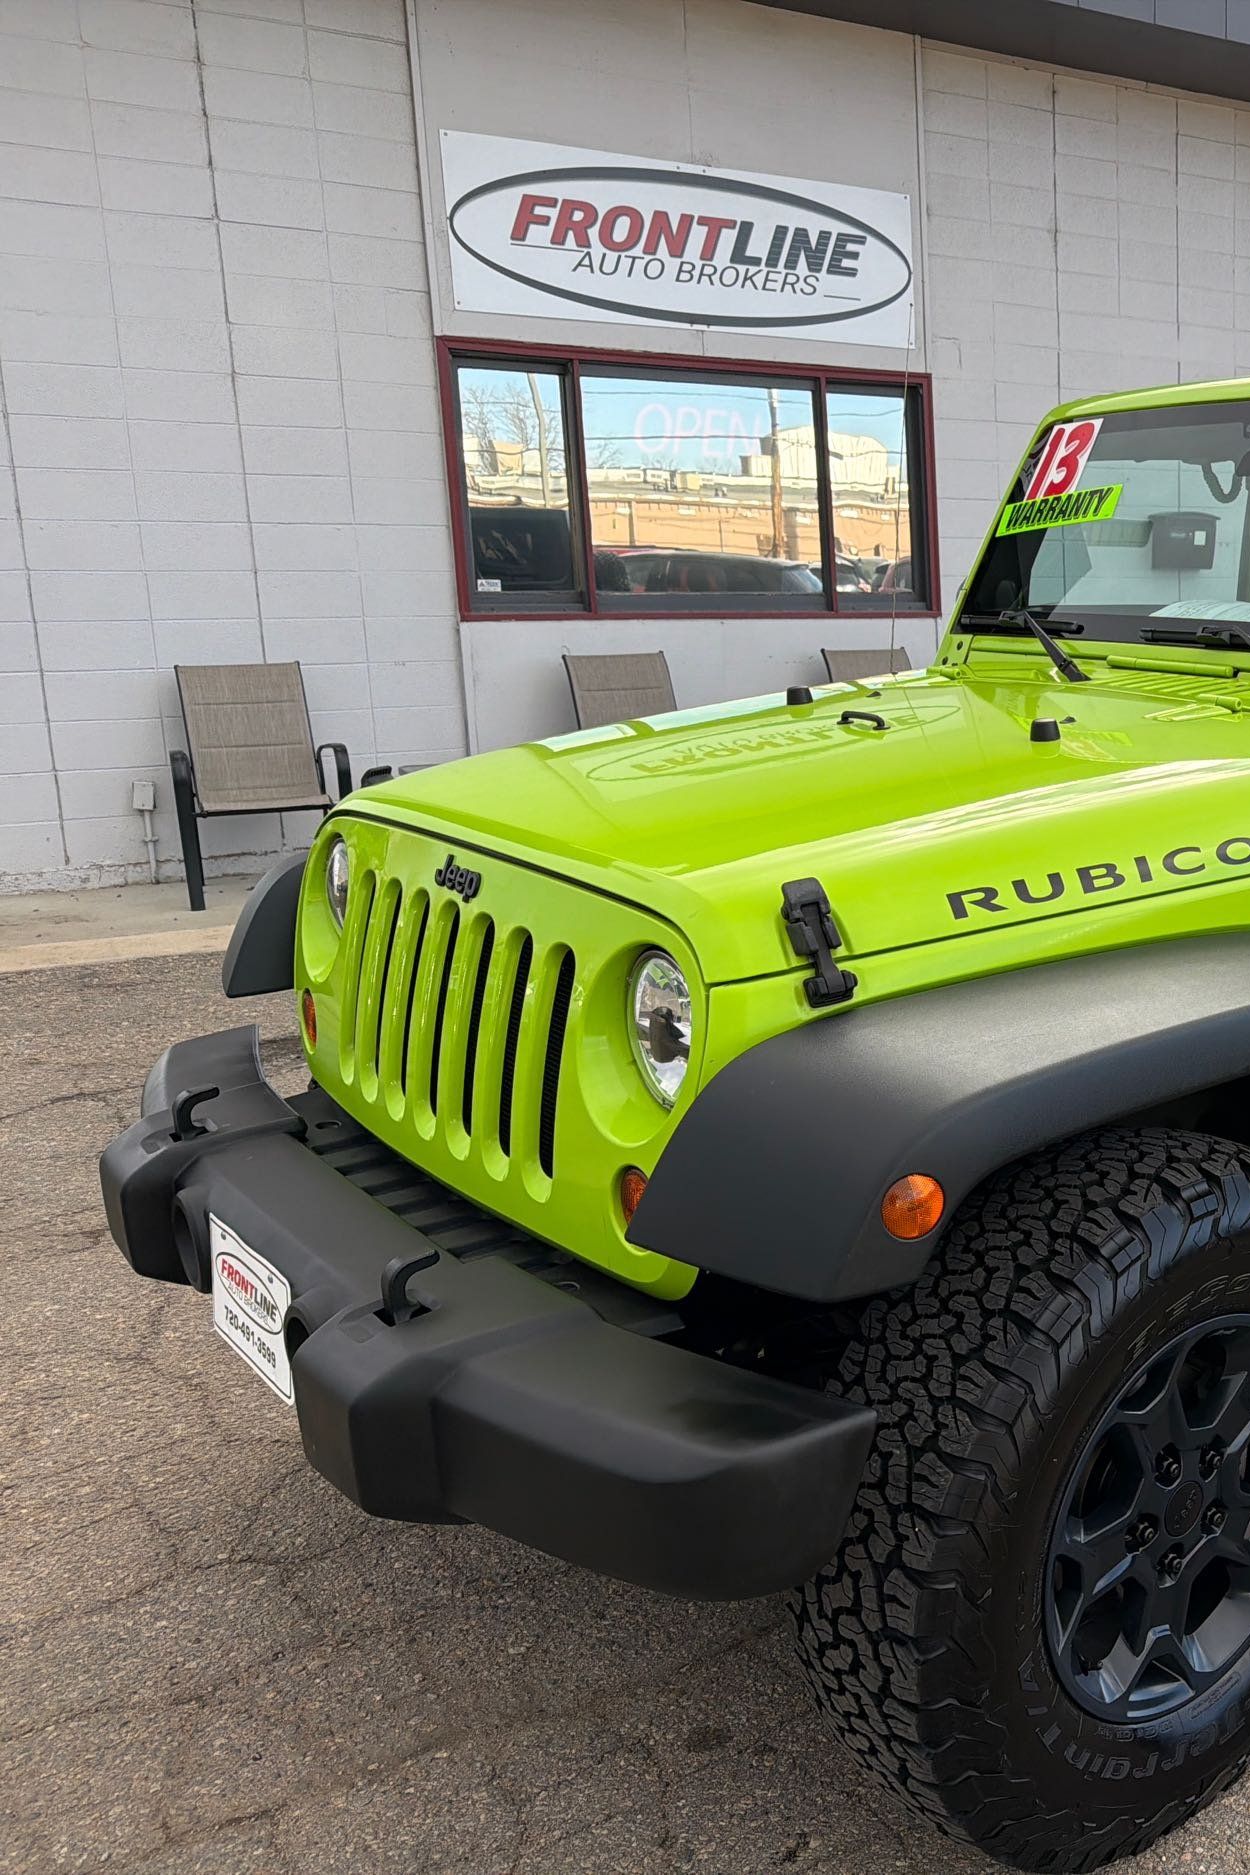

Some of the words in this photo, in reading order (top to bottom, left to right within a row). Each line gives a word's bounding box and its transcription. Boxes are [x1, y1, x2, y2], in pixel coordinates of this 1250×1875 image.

[510, 193, 867, 278] FRONTLINE
[572, 250, 665, 281] AUTO
[675, 260, 820, 296] BROKERS
[633, 403, 761, 459] OPEN
[1025, 422, 1095, 501] 13
[1005, 486, 1114, 531] WARRANTY
[434, 853, 482, 904] Jeep
[221, 1257, 277, 1325] FRONTLINE
